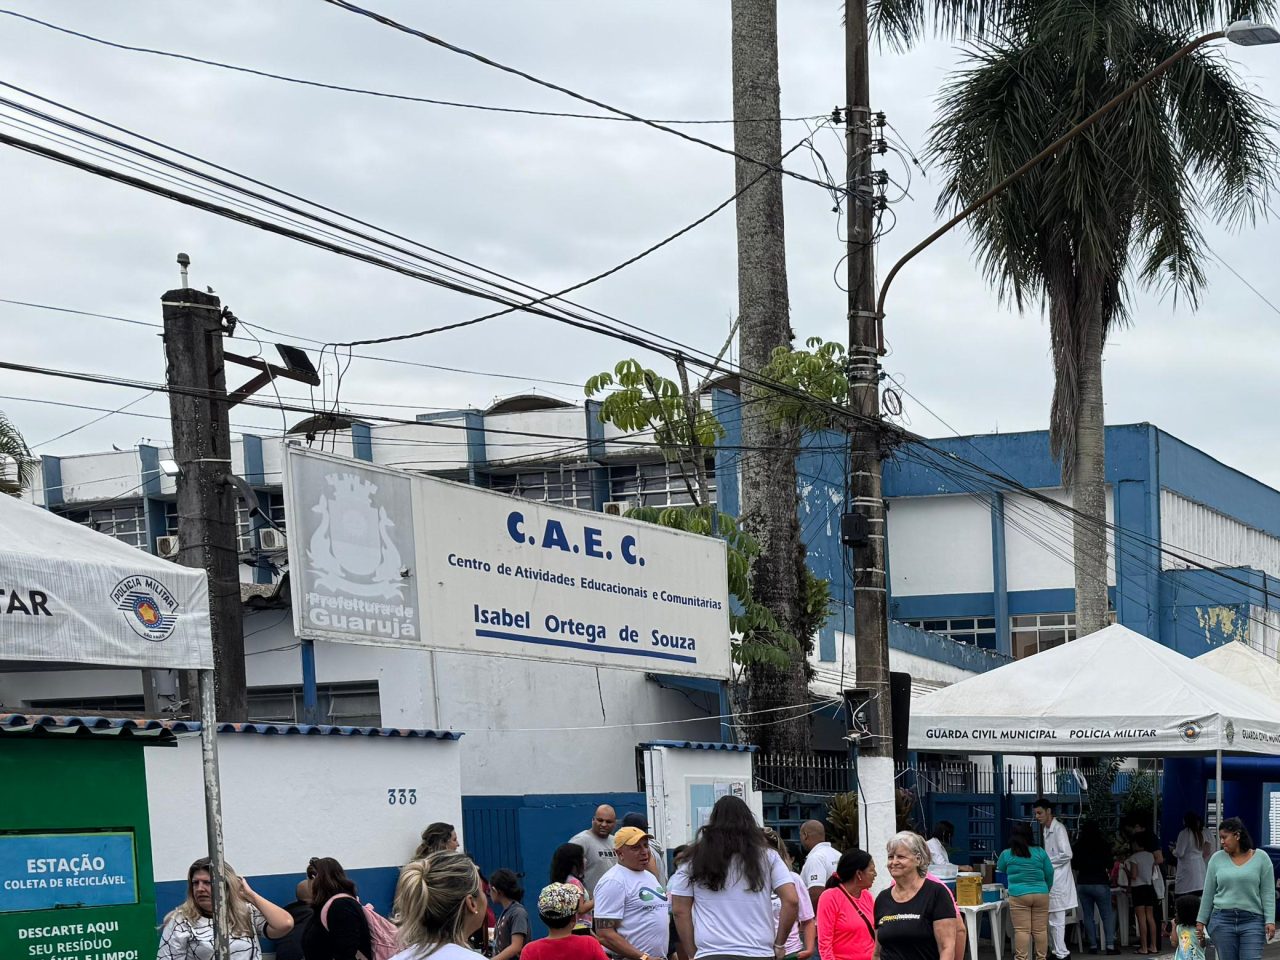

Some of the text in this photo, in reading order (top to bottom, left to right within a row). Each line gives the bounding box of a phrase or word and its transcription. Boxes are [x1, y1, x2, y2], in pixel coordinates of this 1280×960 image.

[447, 553, 722, 610] Centro de Atividades Educacionais e Comunitárias
[144, 578, 175, 609] MILITAR
[309, 592, 414, 618] Prefeitura de
[309, 607, 416, 639] Guarujá
[473, 603, 696, 651] Isabel Ortega de Souza
[925, 726, 1157, 740] GUARDA CIVIL MUNICIPAL POLÍCIA MILITAR
[387, 788, 417, 806] 333
[26, 853, 105, 876] ESTAÇÃO
[3, 874, 126, 890] COLETA DE RECICLÁVEL
[18, 921, 119, 940] DESCARTE AQUI
[28, 938, 112, 956] SEU RESÍDUO
